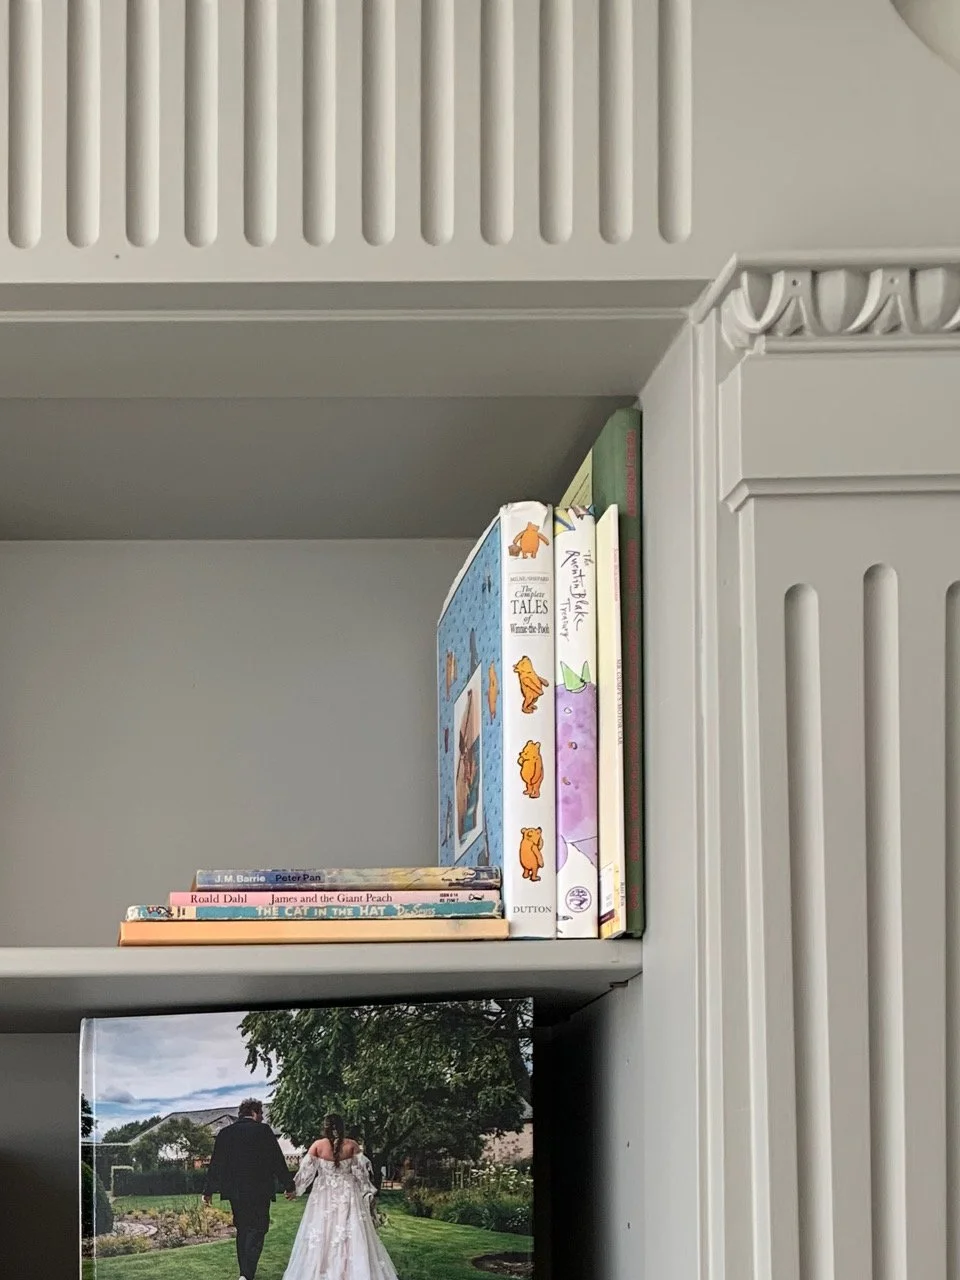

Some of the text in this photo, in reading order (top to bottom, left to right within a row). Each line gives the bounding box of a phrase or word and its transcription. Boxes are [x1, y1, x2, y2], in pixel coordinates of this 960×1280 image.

[191, 893, 248, 904] Roald Dahl
[269, 893, 392, 905] James and the Giant Peach
[513, 905, 552, 914] DUTTON
